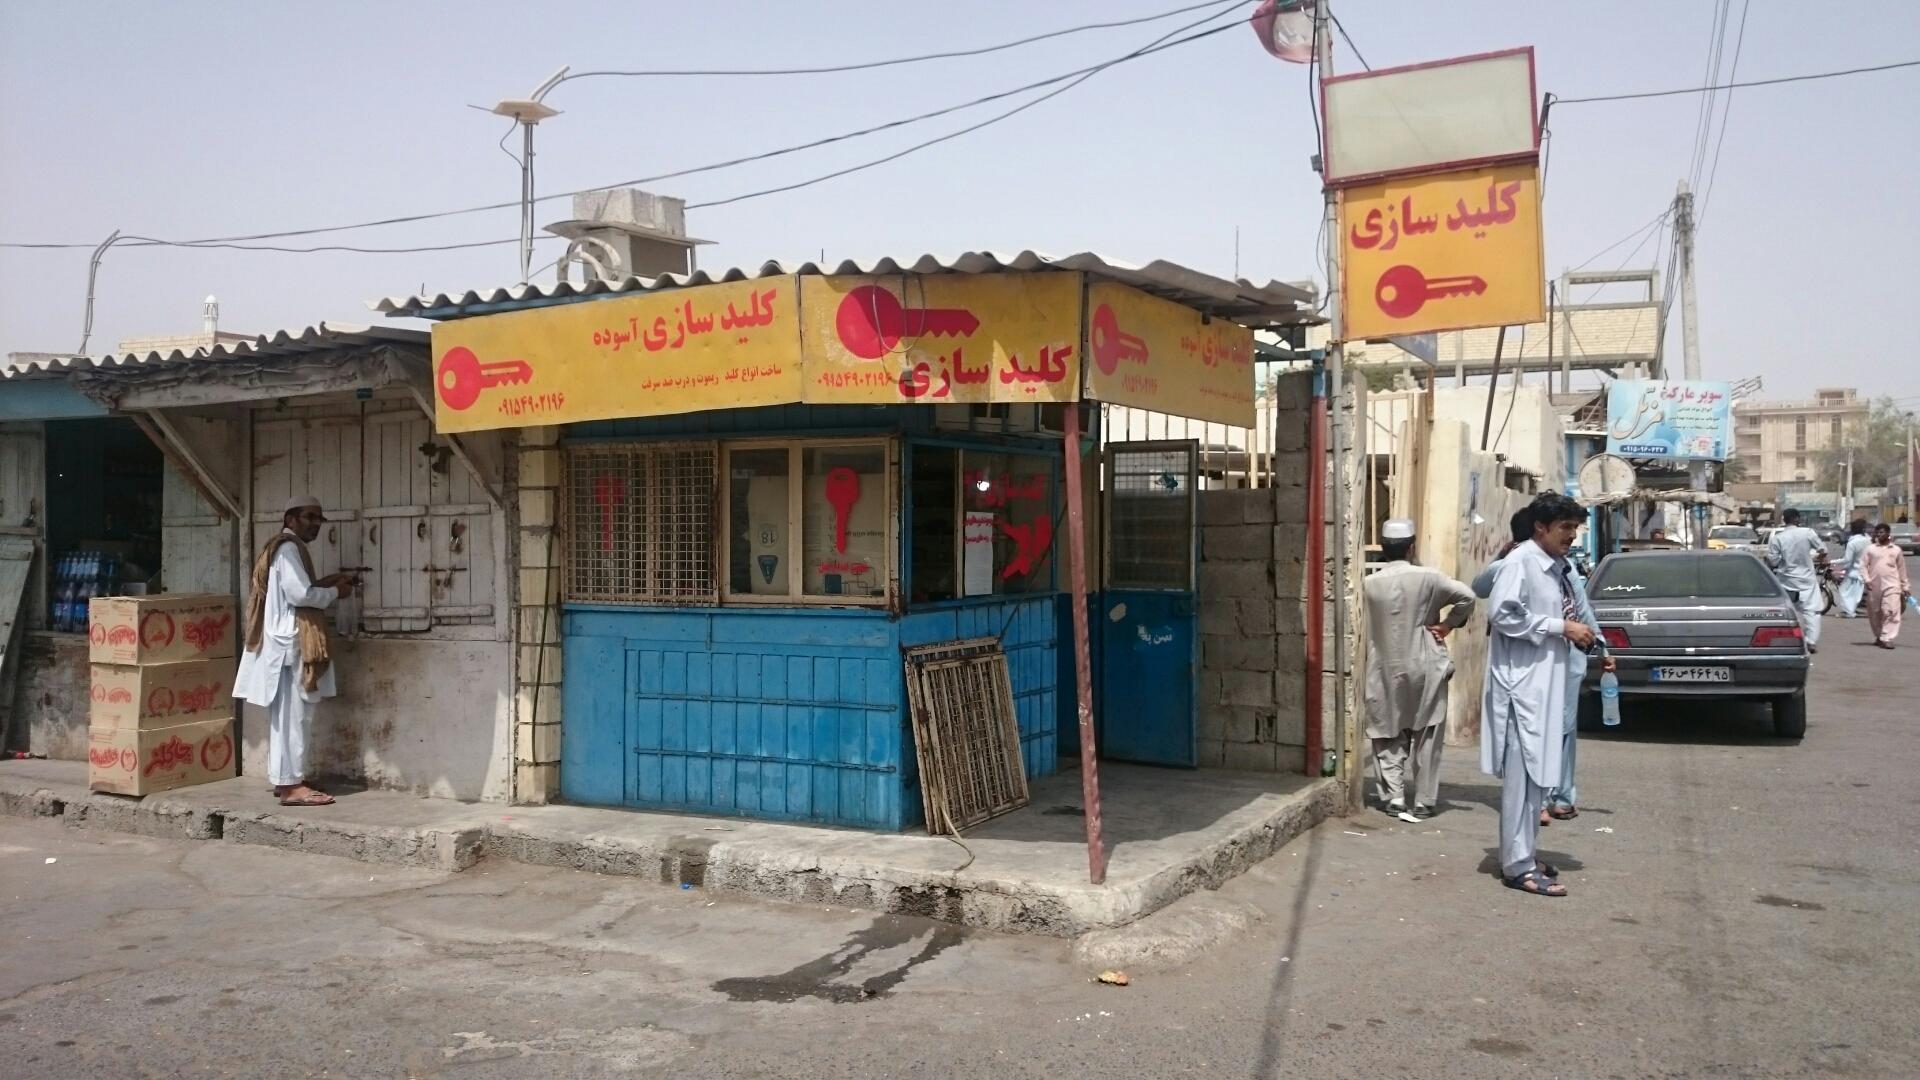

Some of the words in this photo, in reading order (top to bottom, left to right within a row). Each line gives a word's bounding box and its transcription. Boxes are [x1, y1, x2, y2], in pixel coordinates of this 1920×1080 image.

[1350, 194, 1438, 250] سازی
[1446, 179, 1521, 239] کلید
[593, 317, 638, 351] آسوده
[643, 298, 714, 352] سازی
[721, 288, 777, 344] کلید
[725, 367, 739, 381] کلید
[741, 365, 759, 382] انواع
[761, 363, 782, 376] ساخت
[900, 347, 990, 397] سازی
[999, 345, 1073, 394] کلید
[498, 392, 565, 417] ۰۹۱۵۴۹۰۲۱۹۶
